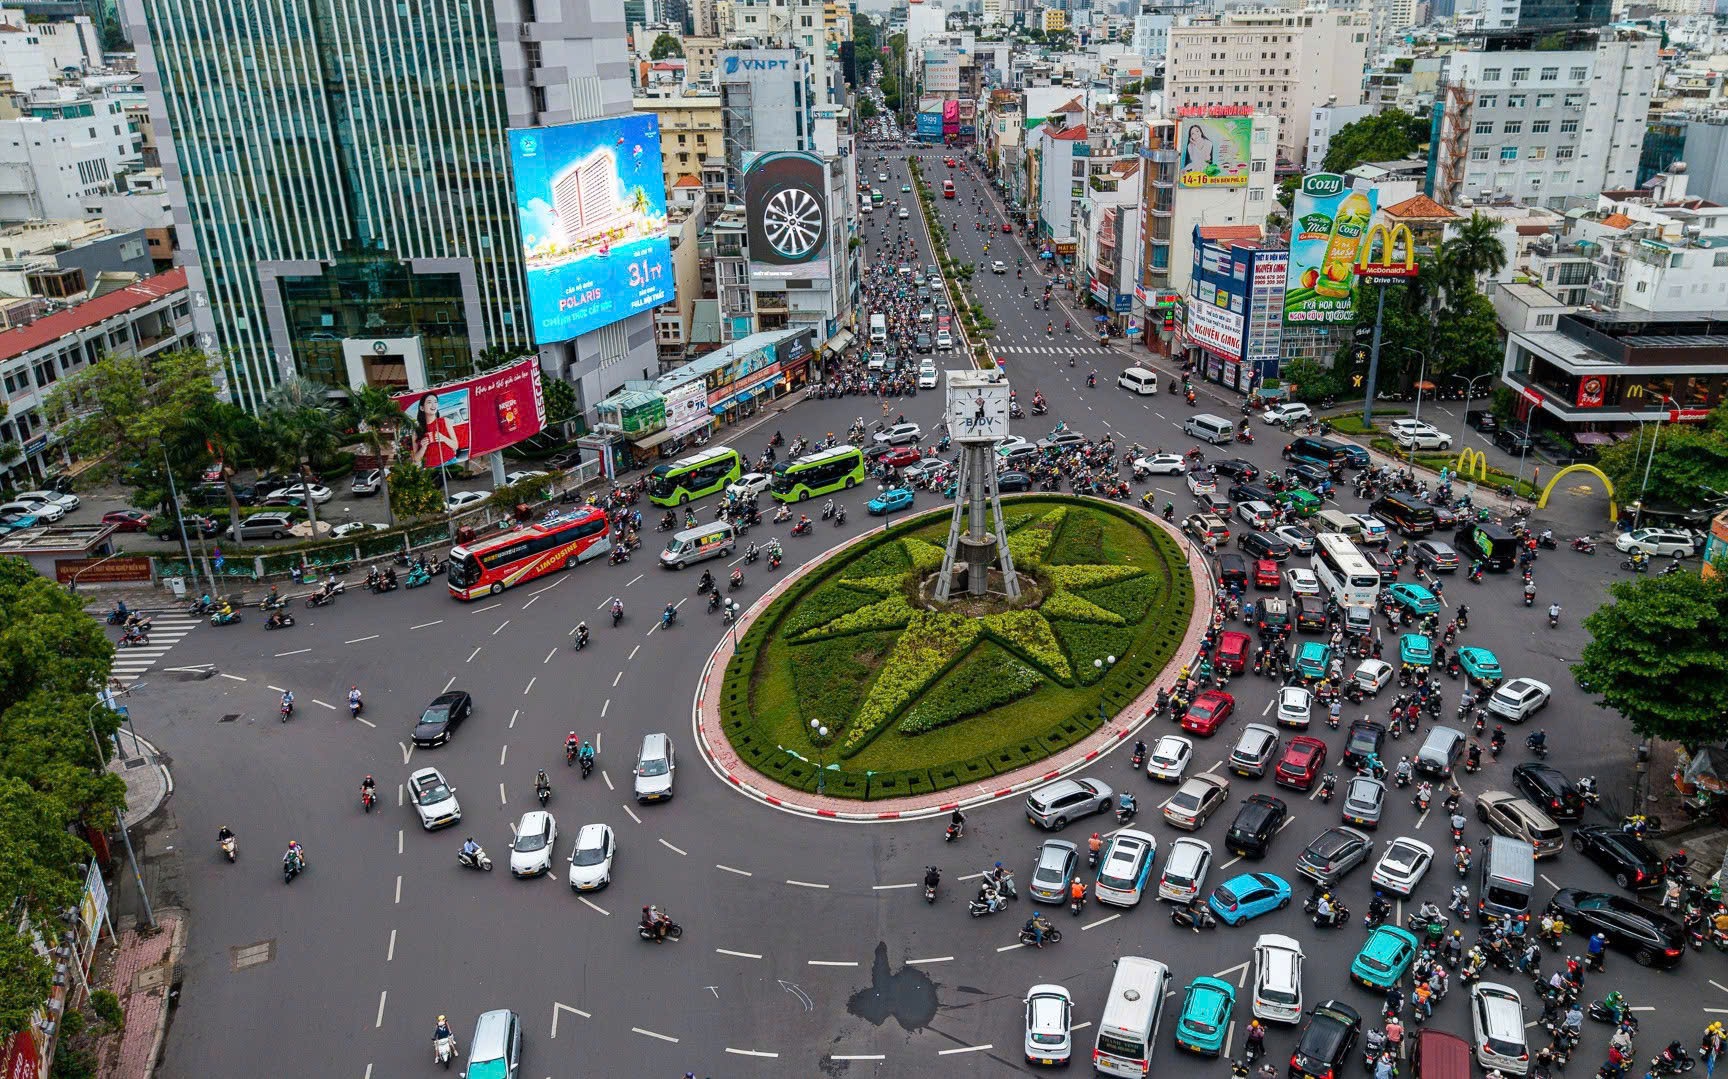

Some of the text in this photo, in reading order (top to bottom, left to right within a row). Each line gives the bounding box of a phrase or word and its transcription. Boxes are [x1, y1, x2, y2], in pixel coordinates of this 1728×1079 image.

[742, 60, 789, 70] VNPT
[1183, 175, 1208, 184] 14-16
[1307, 178, 1340, 193] Cozy
[1307, 222, 1329, 233] Mới
[1340, 224, 1360, 237] Cozy
[1366, 266, 1406, 274] McDonald's
[559, 287, 602, 312] POLARIS
[1318, 300, 1333, 310] HOA
[1194, 323, 1220, 342] NGUYỄN
[1220, 333, 1241, 349] GIANG
[694, 399, 706, 411] 7K
[535, 541, 578, 573] LIMOUSINE
